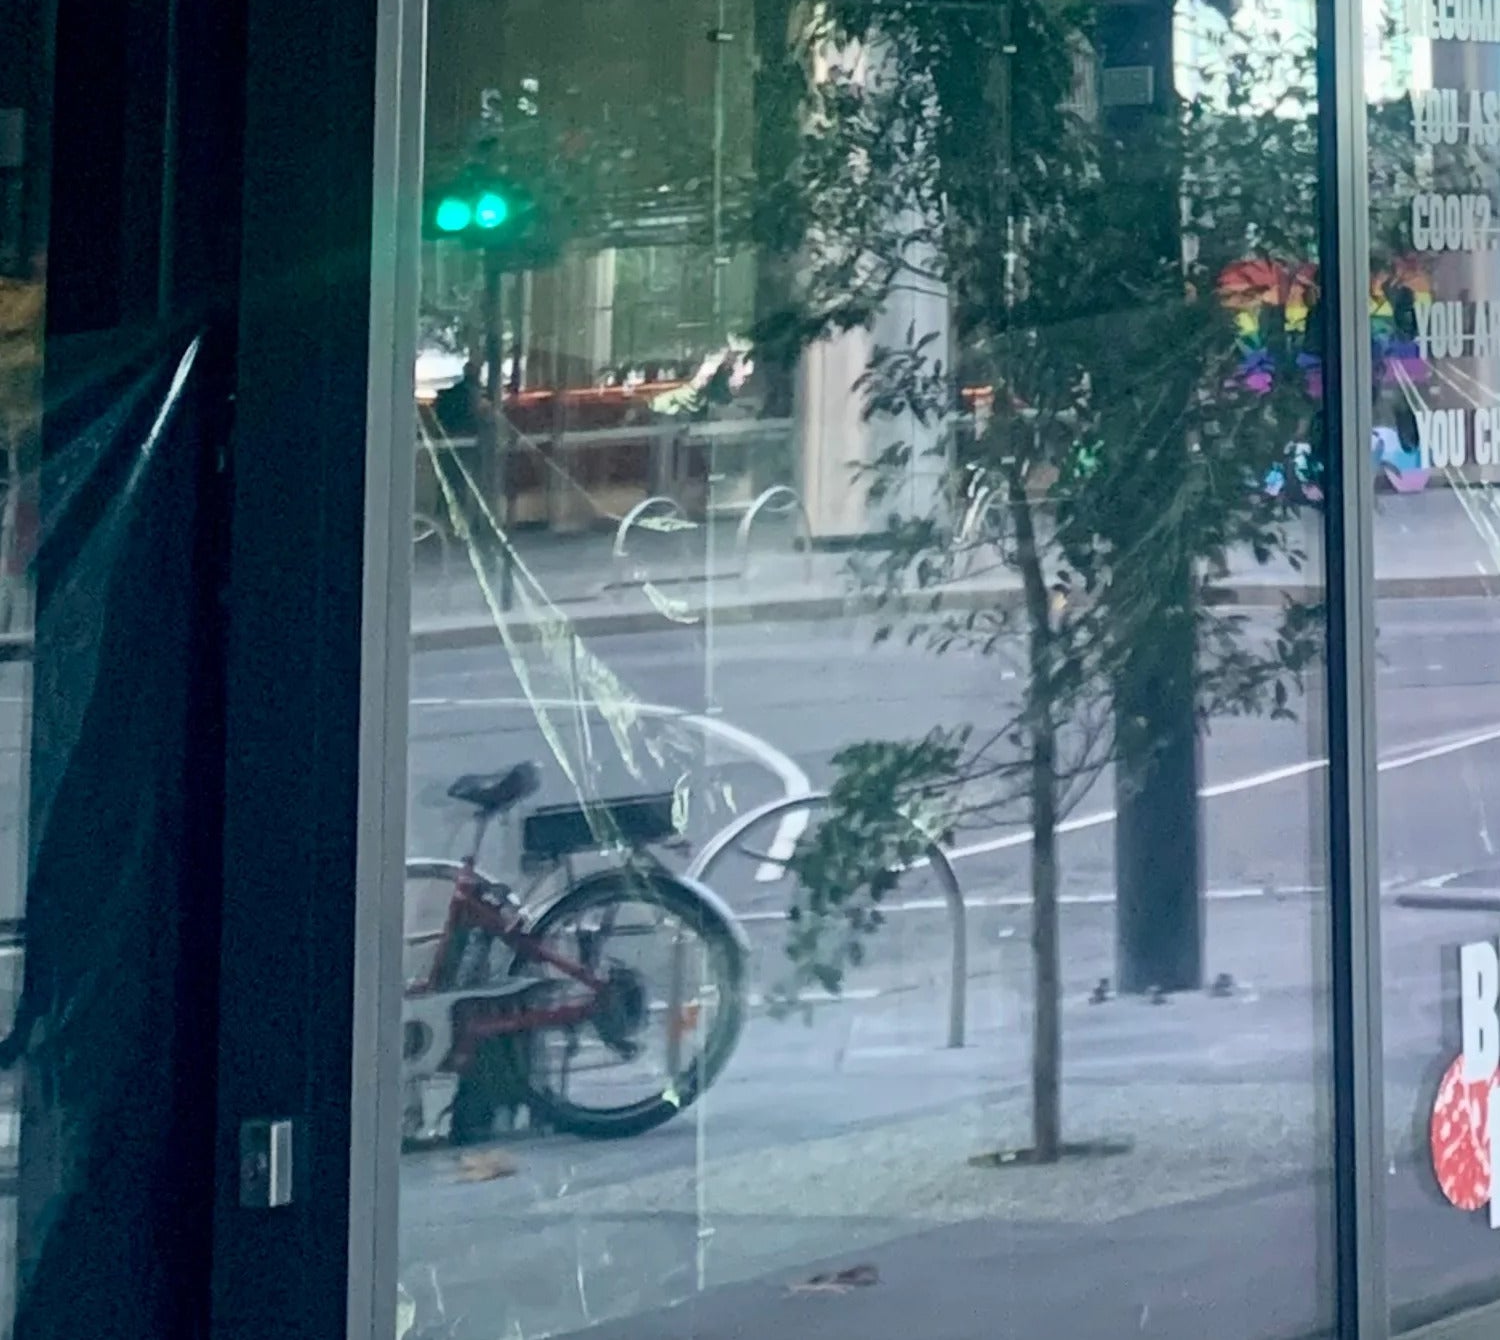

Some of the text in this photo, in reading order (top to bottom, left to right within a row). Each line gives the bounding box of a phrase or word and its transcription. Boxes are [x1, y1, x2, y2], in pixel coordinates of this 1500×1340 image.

[1411, 89, 1458, 145] YOU
[1414, 301, 1463, 359] YOU
[1416, 409, 1466, 468] YOU
